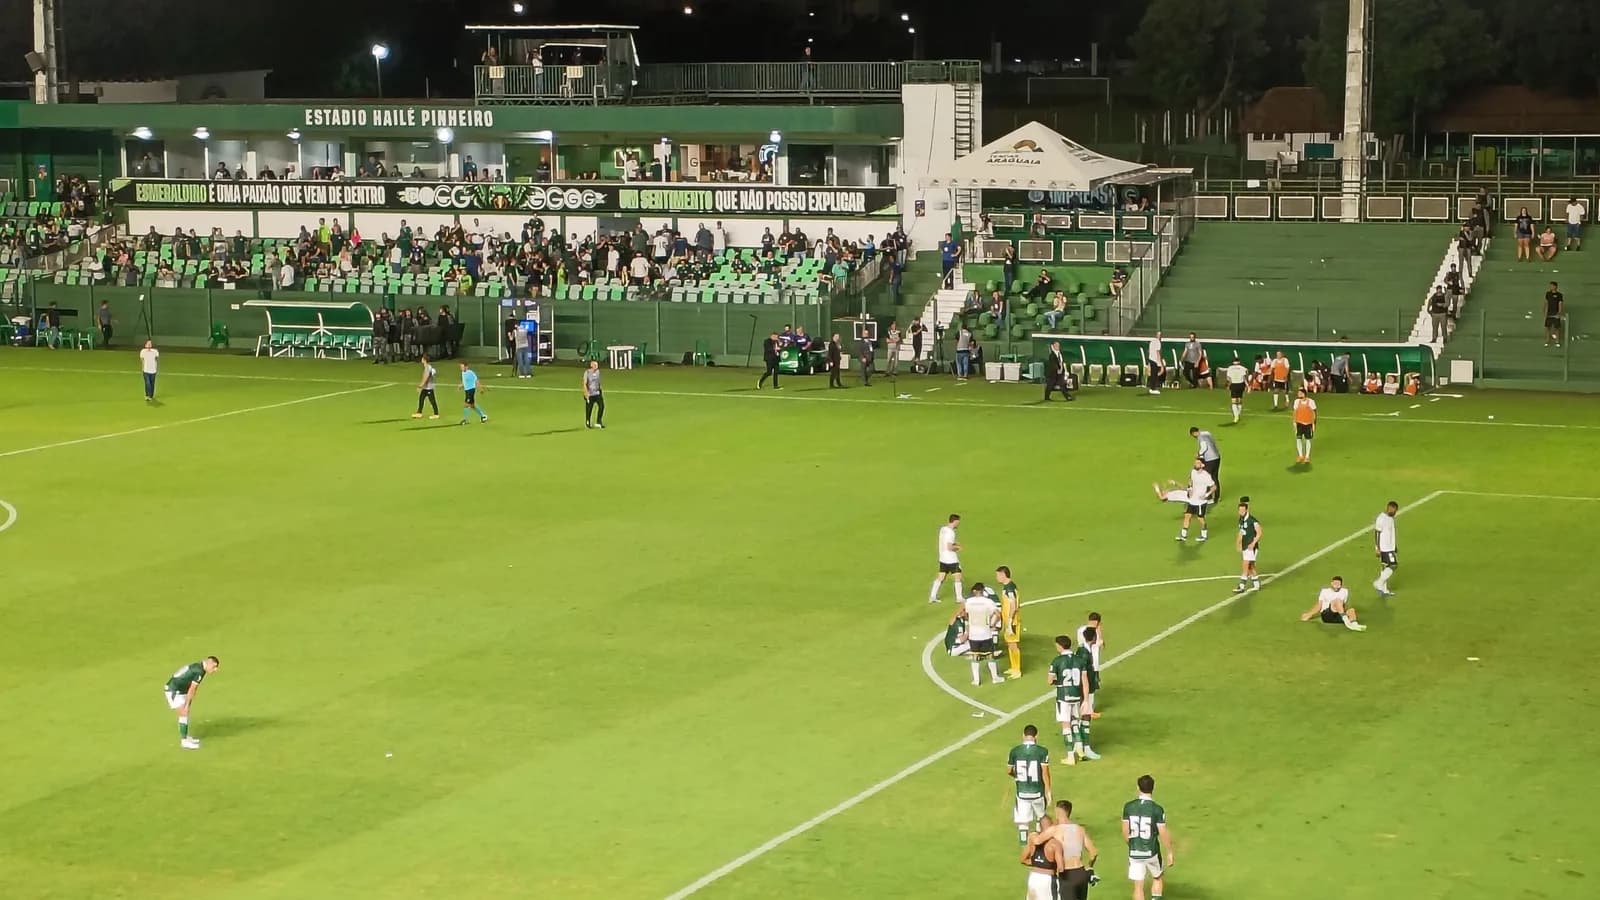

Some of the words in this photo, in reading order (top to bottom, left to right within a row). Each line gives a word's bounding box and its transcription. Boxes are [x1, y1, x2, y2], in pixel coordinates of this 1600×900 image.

[305, 109, 367, 126] ESTADIO
[373, 107, 416, 127] HAILÉ
[421, 109, 494, 127] PINHEIRO
[135, 183, 207, 203] ESMERALDINO
[209, 182, 216, 203] É
[217, 184, 241, 203] UMA
[242, 183, 280, 204] PAIXÃO
[281, 185, 303, 206] QUE
[303, 185, 327, 204] VEM
[328, 185, 343, 205] DE
[343, 185, 386, 205] DENTRO
[619, 189, 639, 209] UM
[640, 189, 713, 210] SENTIMENTO
[715, 190, 738, 212] QUE
[740, 189, 764, 211] NÃO
[766, 190, 806, 211] POSSO
[808, 191, 866, 212] EXPLICAR
[1015, 760, 1039, 782] 54
[1128, 815, 1151, 840] 55
